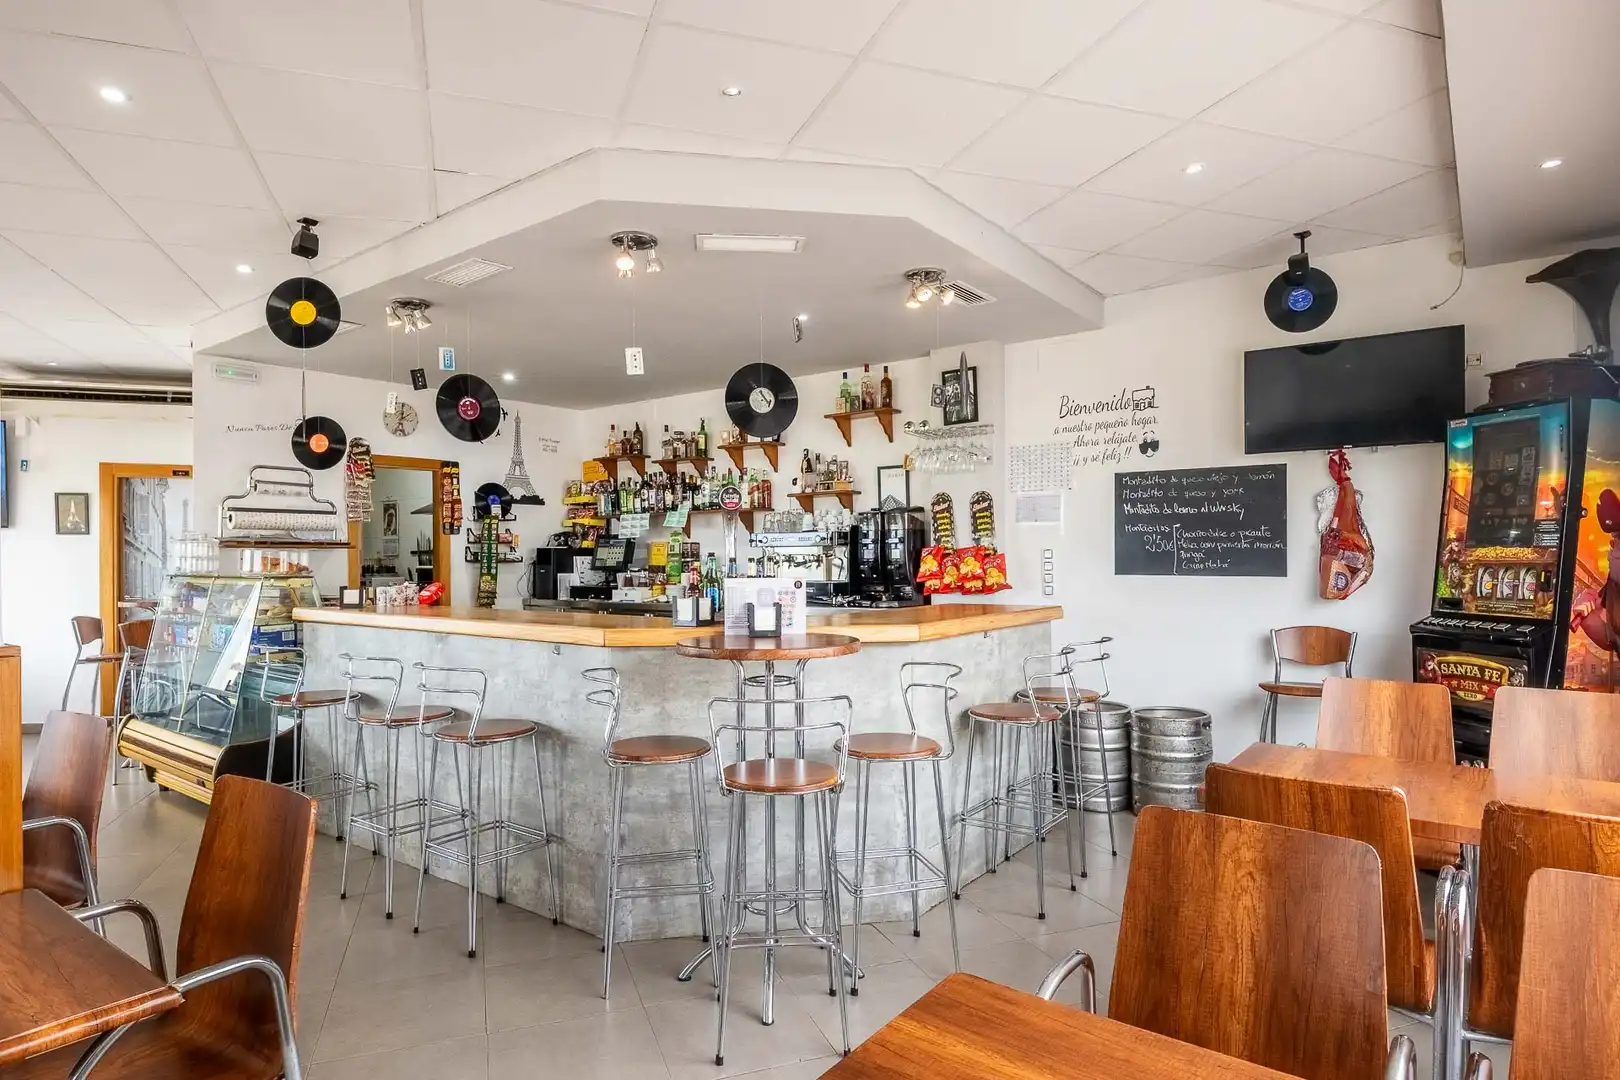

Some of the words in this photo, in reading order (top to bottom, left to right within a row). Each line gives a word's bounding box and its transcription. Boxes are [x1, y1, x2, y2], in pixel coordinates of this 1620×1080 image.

[1060, 388, 1131, 418] Bienvenido
[226, 424, 254, 433] Nunca
[1062, 420, 1092, 433] nuestro
[1094, 417, 1128, 434] pequeño
[1073, 434, 1099, 448] Ahora
[1101, 447, 1121, 465] feliz
[1162, 502, 1173, 514] de
[1440, 663, 1481, 677] SANTA
[1484, 668, 1501, 682] FE
[1460, 680, 1480, 691] MIX
